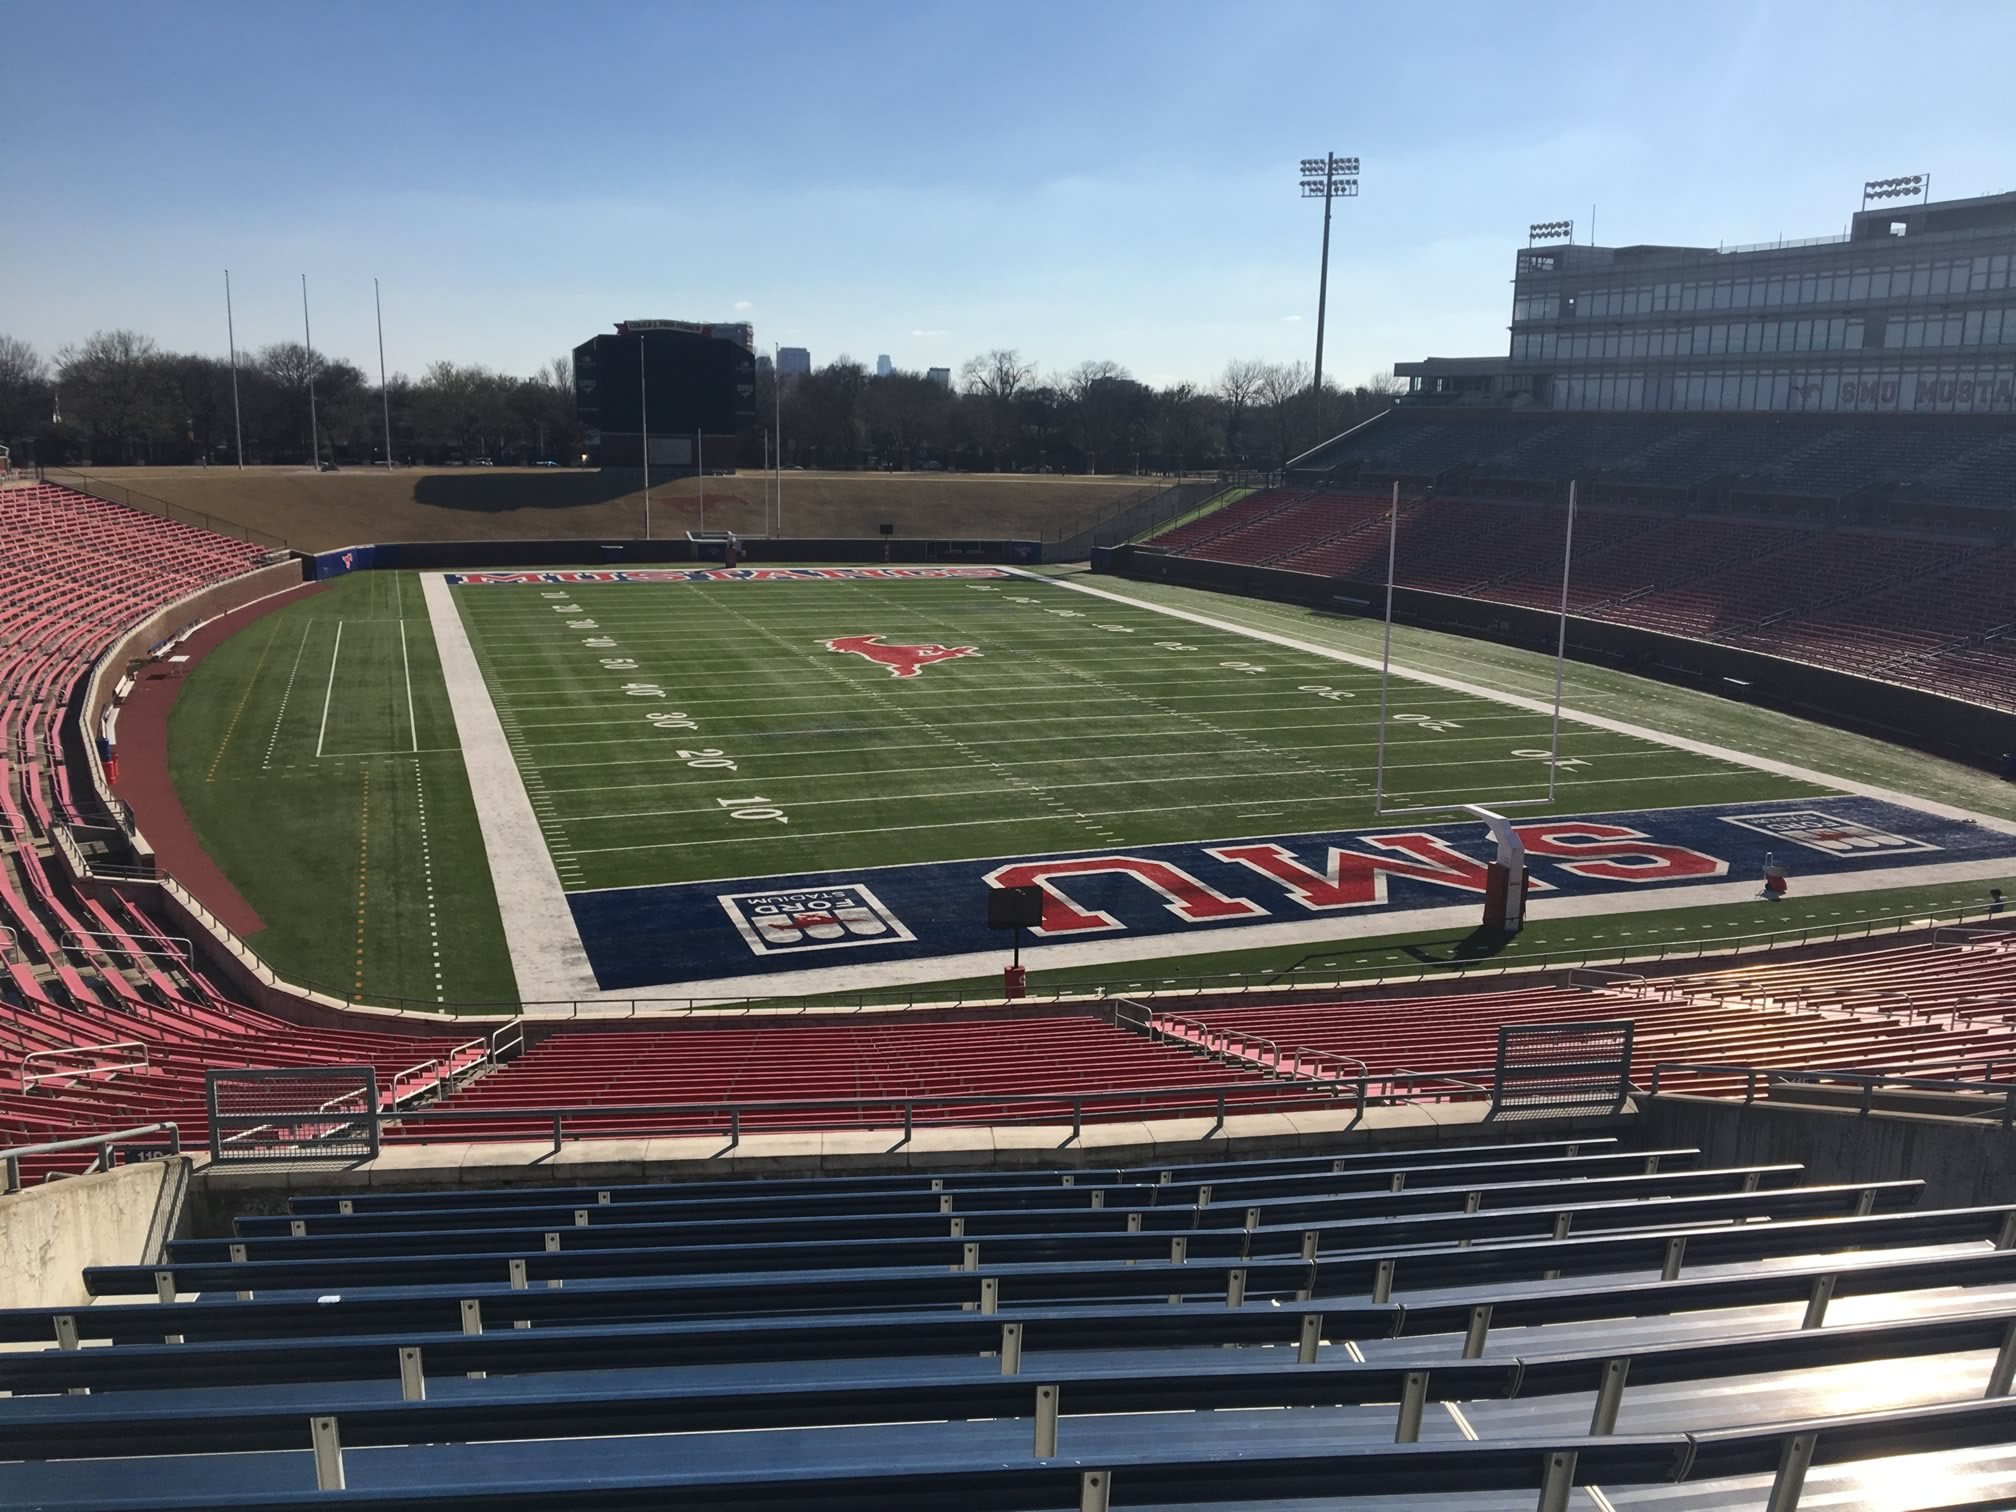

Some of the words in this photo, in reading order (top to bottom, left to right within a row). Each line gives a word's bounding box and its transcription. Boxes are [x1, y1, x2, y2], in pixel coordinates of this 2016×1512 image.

[1841, 381, 1900, 403] SMU
[455, 567, 1010, 584] MUSTANGS
[599, 658, 639, 669] 50
[621, 683, 665, 696] 40
[1297, 685, 1356, 700] 30
[646, 712, 696, 729] 30
[1392, 713, 1464, 731] 20
[675, 748, 735, 769] 20
[1510, 749, 1593, 770] 10
[716, 795, 784, 821] 10
[980, 821, 1730, 938] SMU
[748, 891, 846, 905] STADIUM
[754, 898, 856, 914] FORD
